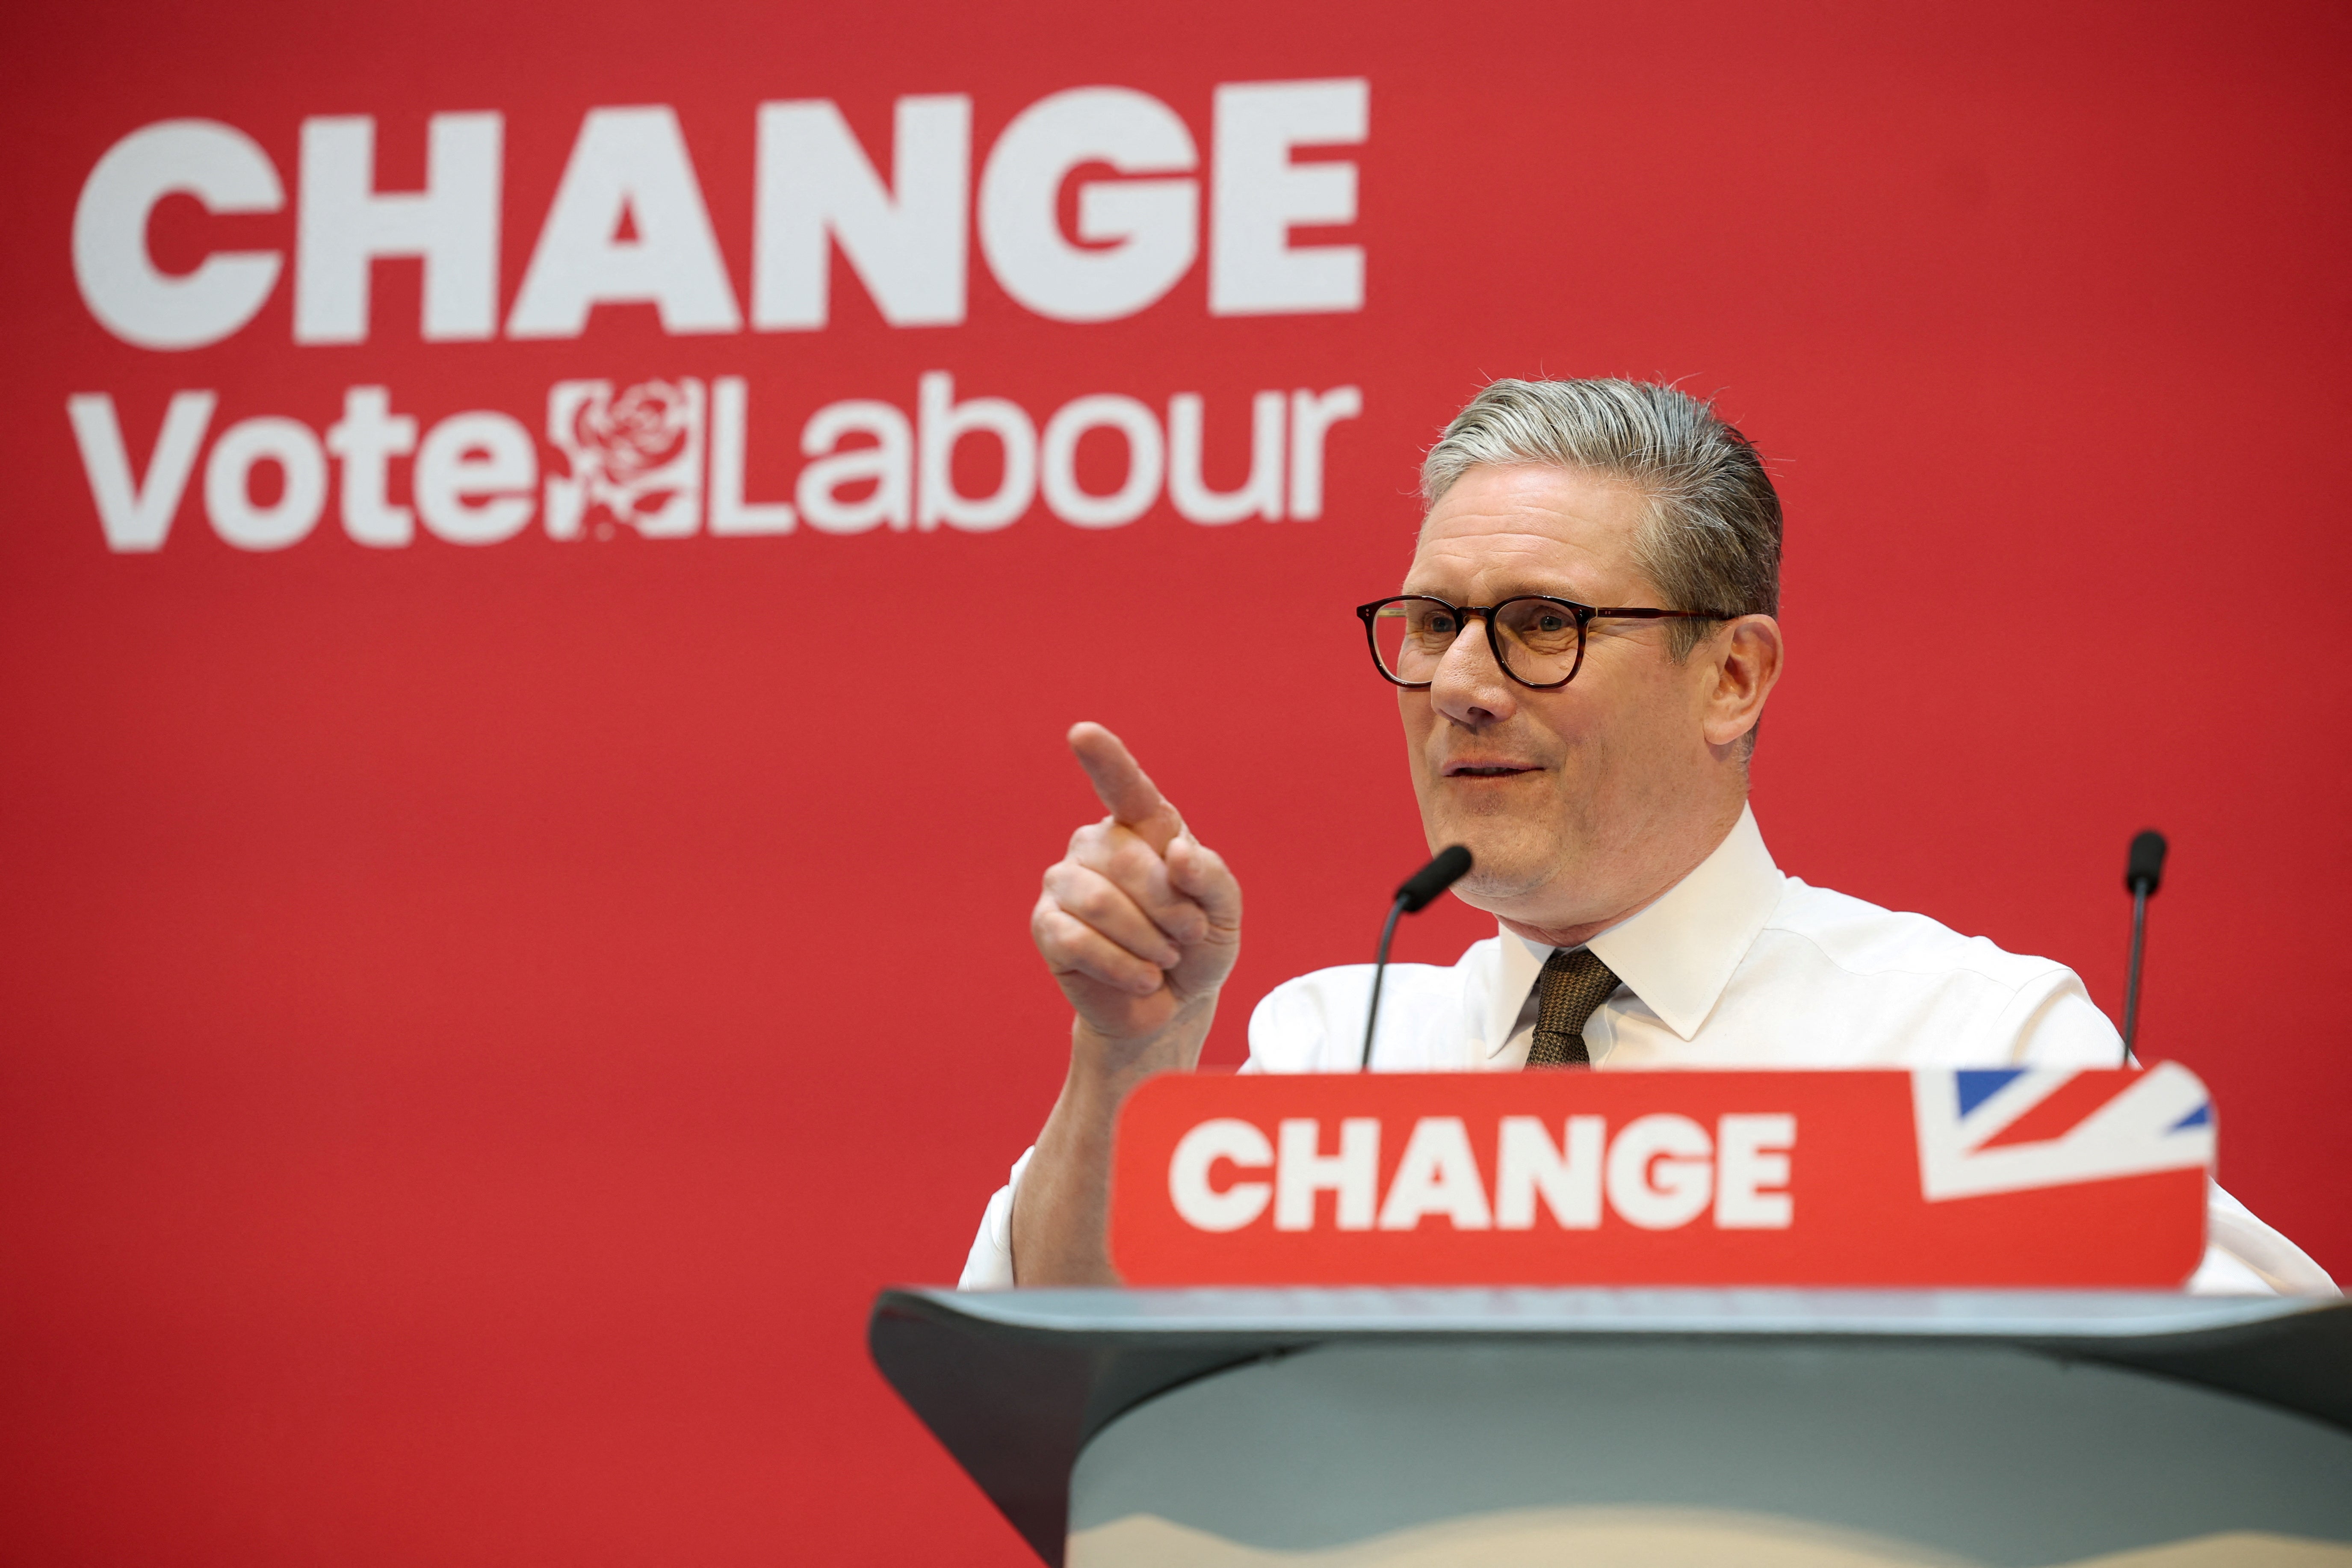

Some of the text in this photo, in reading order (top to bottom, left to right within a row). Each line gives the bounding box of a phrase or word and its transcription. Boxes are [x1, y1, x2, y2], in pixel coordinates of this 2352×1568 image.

[71, 77, 1370, 351] CHANGE
[67, 371, 1363, 553] Vote Labour
[1169, 1113, 1797, 1231] CHANGE
